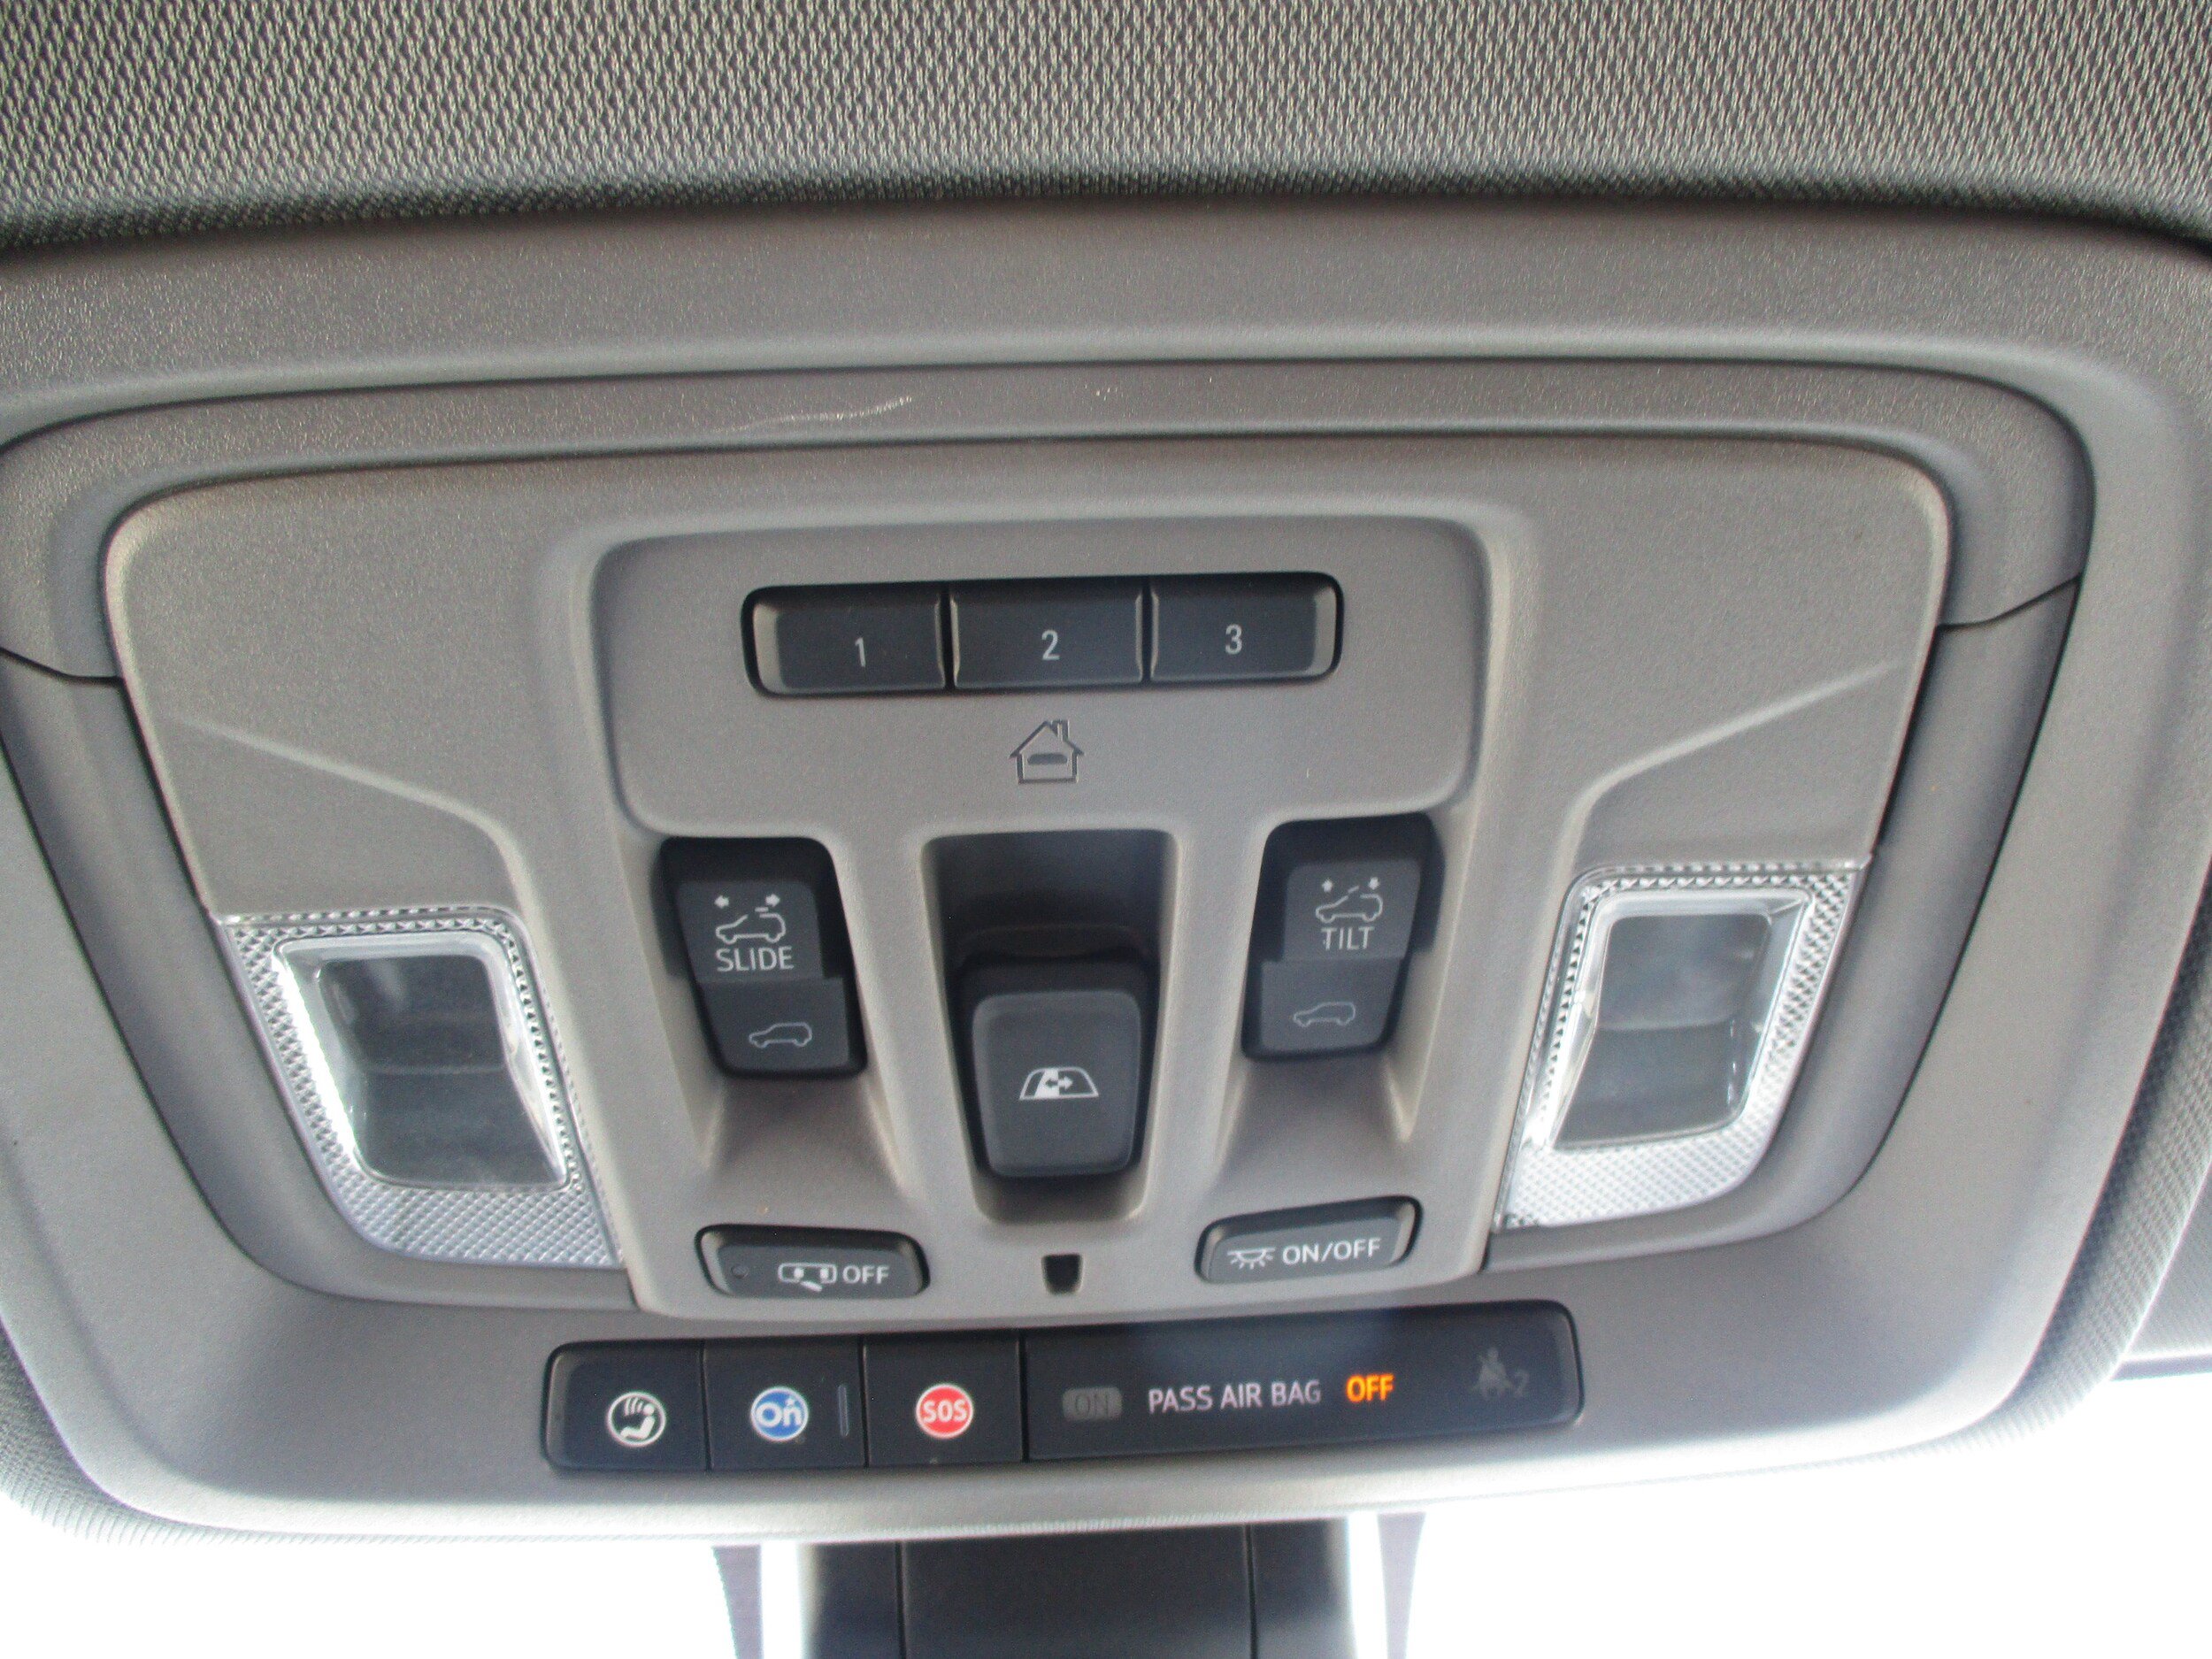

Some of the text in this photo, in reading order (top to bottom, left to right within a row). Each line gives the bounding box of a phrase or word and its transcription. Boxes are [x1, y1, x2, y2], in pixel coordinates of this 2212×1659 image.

[855, 638, 865, 667] 1
[1042, 630, 1060, 661] 2
[1225, 625, 1243, 655] 3
[1321, 926, 1375, 950] TILT
[716, 945, 794, 972] SLIDE
[1282, 1237, 1382, 1265] ON/OFF
[841, 1264, 889, 1285] OFF
[1073, 1392, 1110, 1416] ON
[1148, 1386, 1213, 1414] PASS
[1221, 1383, 1263, 1409] AIR
[1271, 1379, 1321, 1407] BAG
[1346, 1373, 1394, 1402] OFF
[923, 1398, 968, 1424] SOS
